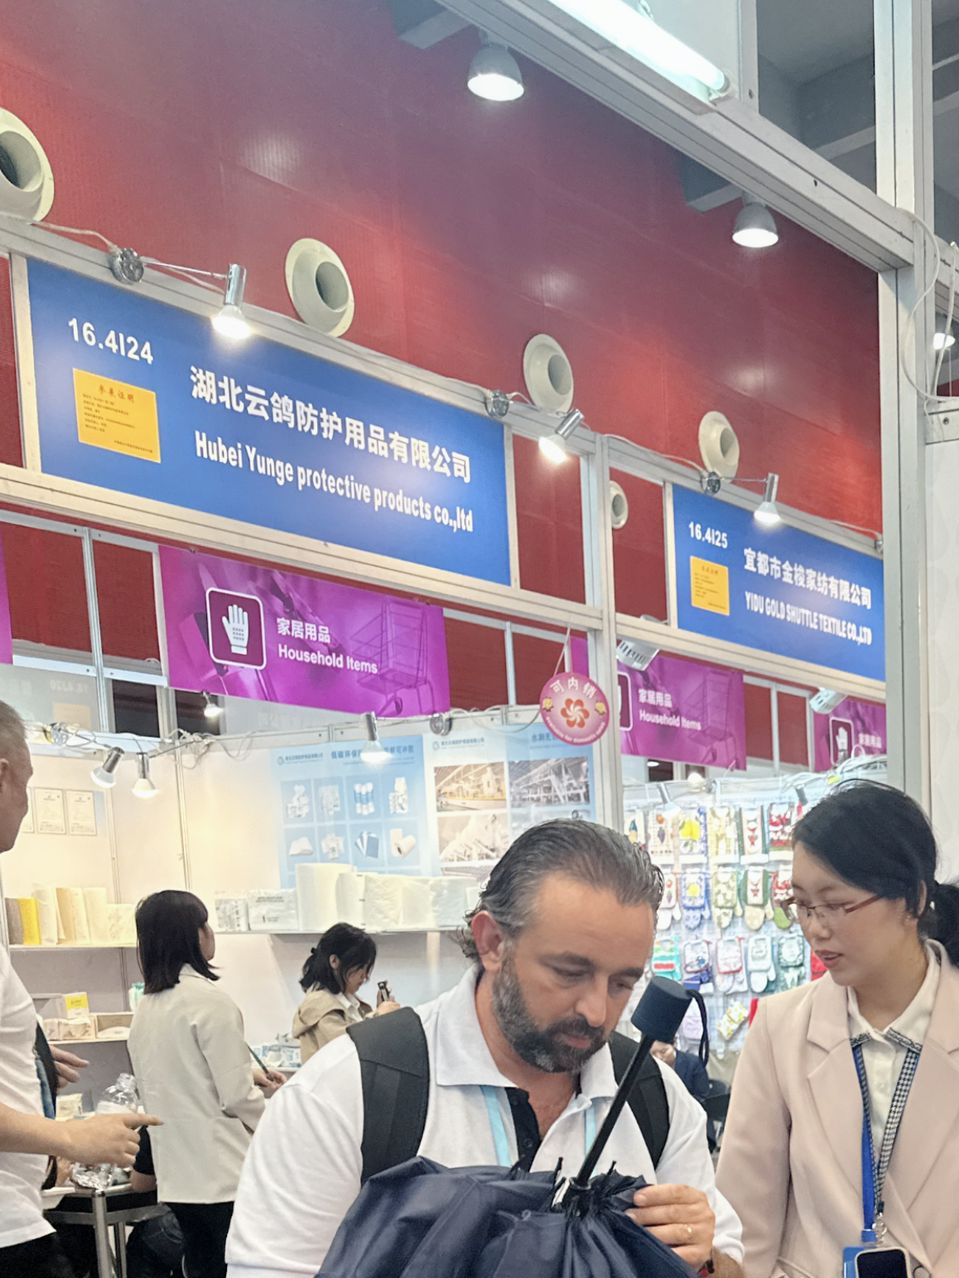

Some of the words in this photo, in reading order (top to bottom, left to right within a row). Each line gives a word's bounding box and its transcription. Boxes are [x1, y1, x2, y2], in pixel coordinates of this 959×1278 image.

[190, 365, 471, 483] 湖北云鸽防护用品有限公司
[195, 430, 243, 468] Hubei
[245, 445, 294, 486] Yunge
[297, 465, 371, 504] protective
[374, 488, 432, 521] products
[434, 505, 474, 533] co.,ltd
[276, 617, 331, 643] 家居用品
[745, 591, 764, 614] YIDU
[765, 597, 785, 620] GOLD
[786, 604, 818, 630] SHUTTLE
[819, 613, 847, 639] TEXTILE
[278, 643, 344, 669] Household
[346, 655, 378, 674] Items
